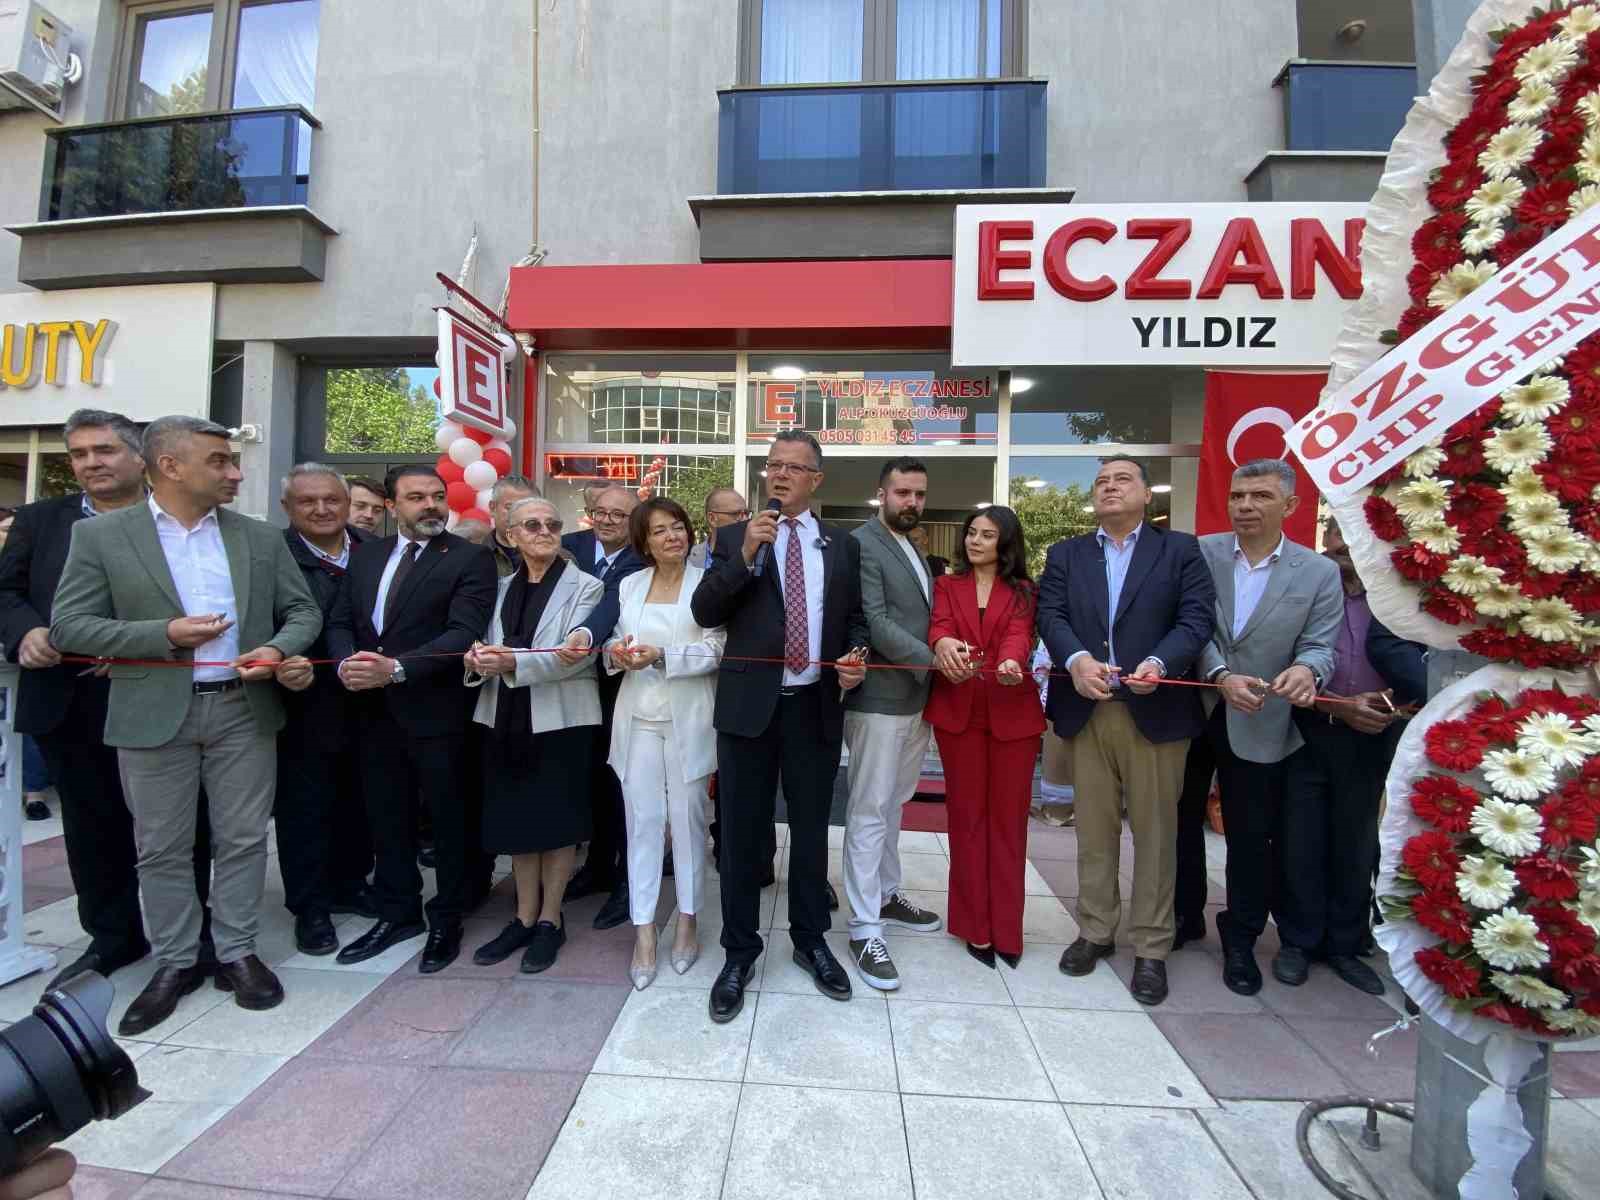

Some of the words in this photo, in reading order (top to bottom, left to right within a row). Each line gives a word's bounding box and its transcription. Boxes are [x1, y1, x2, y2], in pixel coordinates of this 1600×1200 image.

[1131, 316, 1277, 348] YILDIZ
[0, 319, 113, 387] UTY
[464, 343, 492, 412] E
[815, 378, 887, 398] YILDIZ
[888, 376, 992, 398] ECZANESİ
[1328, 393, 1444, 485] CHP
[1464, 281, 1600, 388] GEN
[764, 382, 798, 422] E
[838, 406, 865, 420] ALP
[819, 429, 853, 443] 0505
